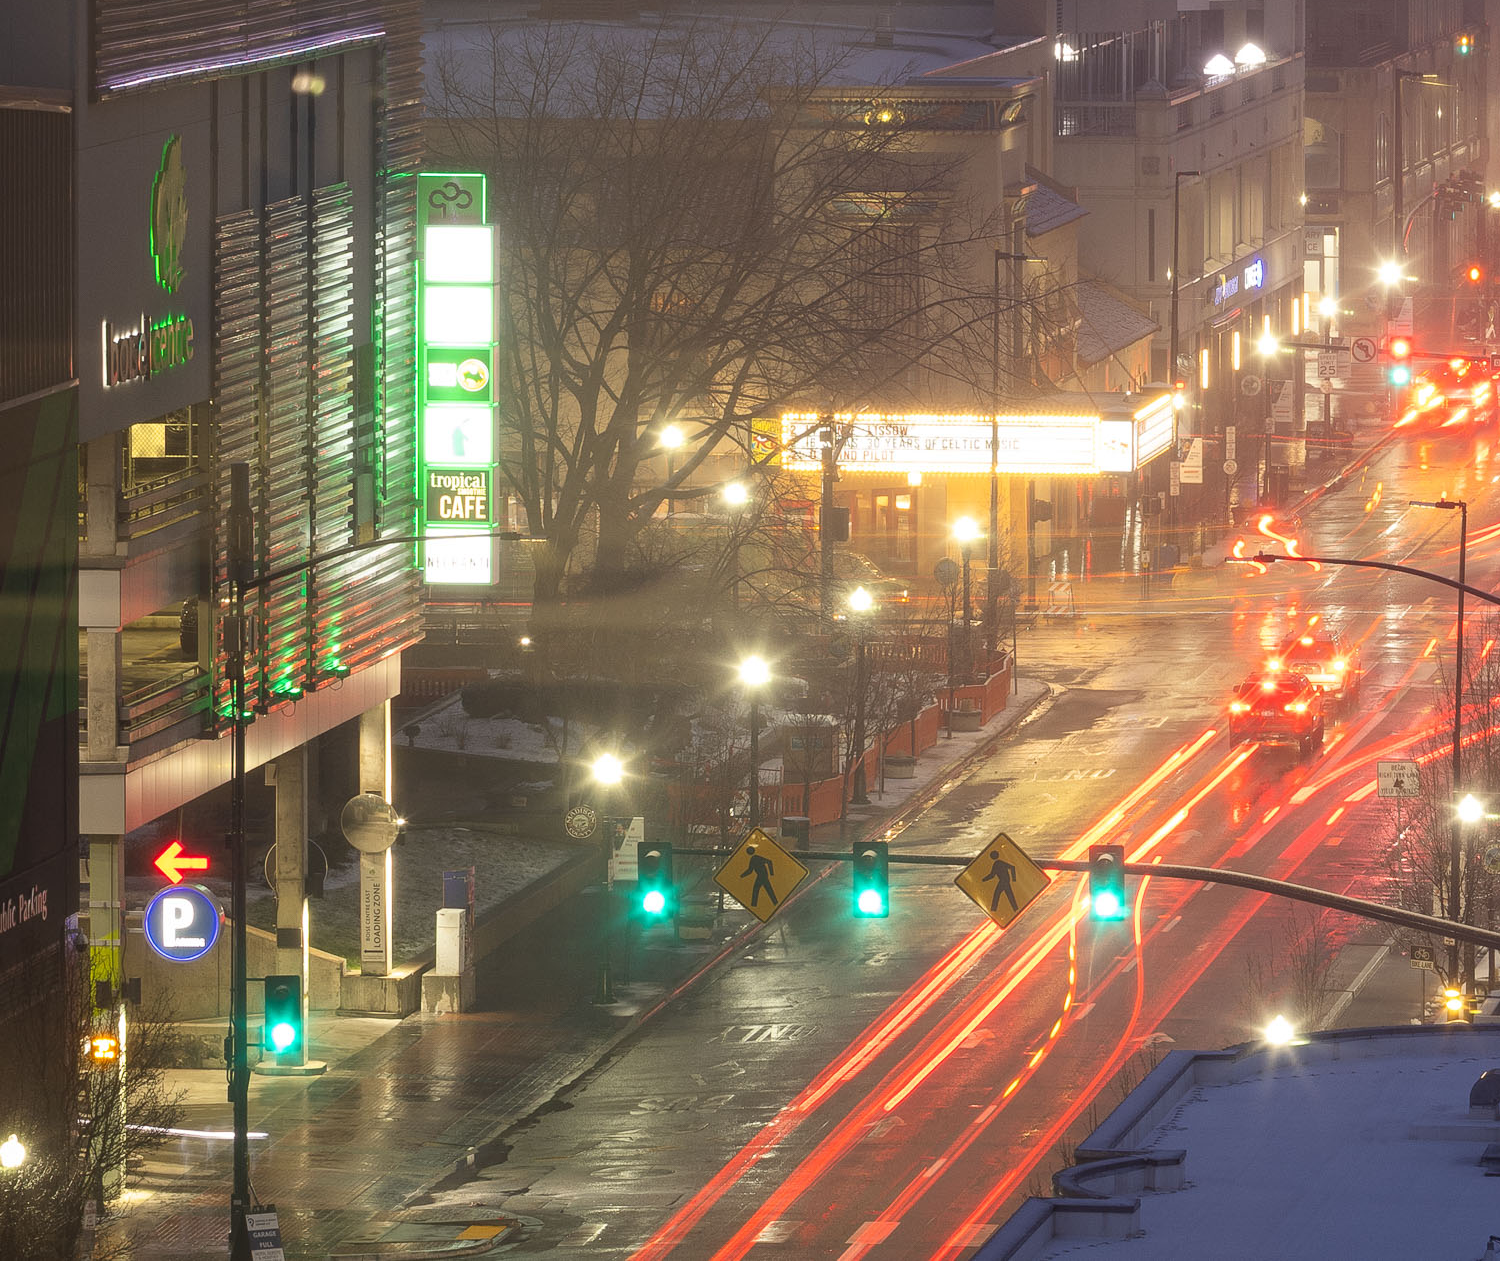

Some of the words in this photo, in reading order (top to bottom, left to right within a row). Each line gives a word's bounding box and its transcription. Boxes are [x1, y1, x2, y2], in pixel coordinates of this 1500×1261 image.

[1319, 365, 1336, 376] 25
[867, 438, 880, 448] 30
[884, 438, 920, 450] YEARS
[925, 439, 937, 450] OF
[942, 439, 980, 450] CELTIC
[985, 439, 1021, 450] MSIC
[863, 450, 894, 461] PILOT
[430, 472, 486, 490] tropical
[440, 495, 487, 519] CAFE
[19, 884, 48, 922] Parking
[373, 883, 381, 907] ZONE
[373, 908, 381, 948] LOADING
